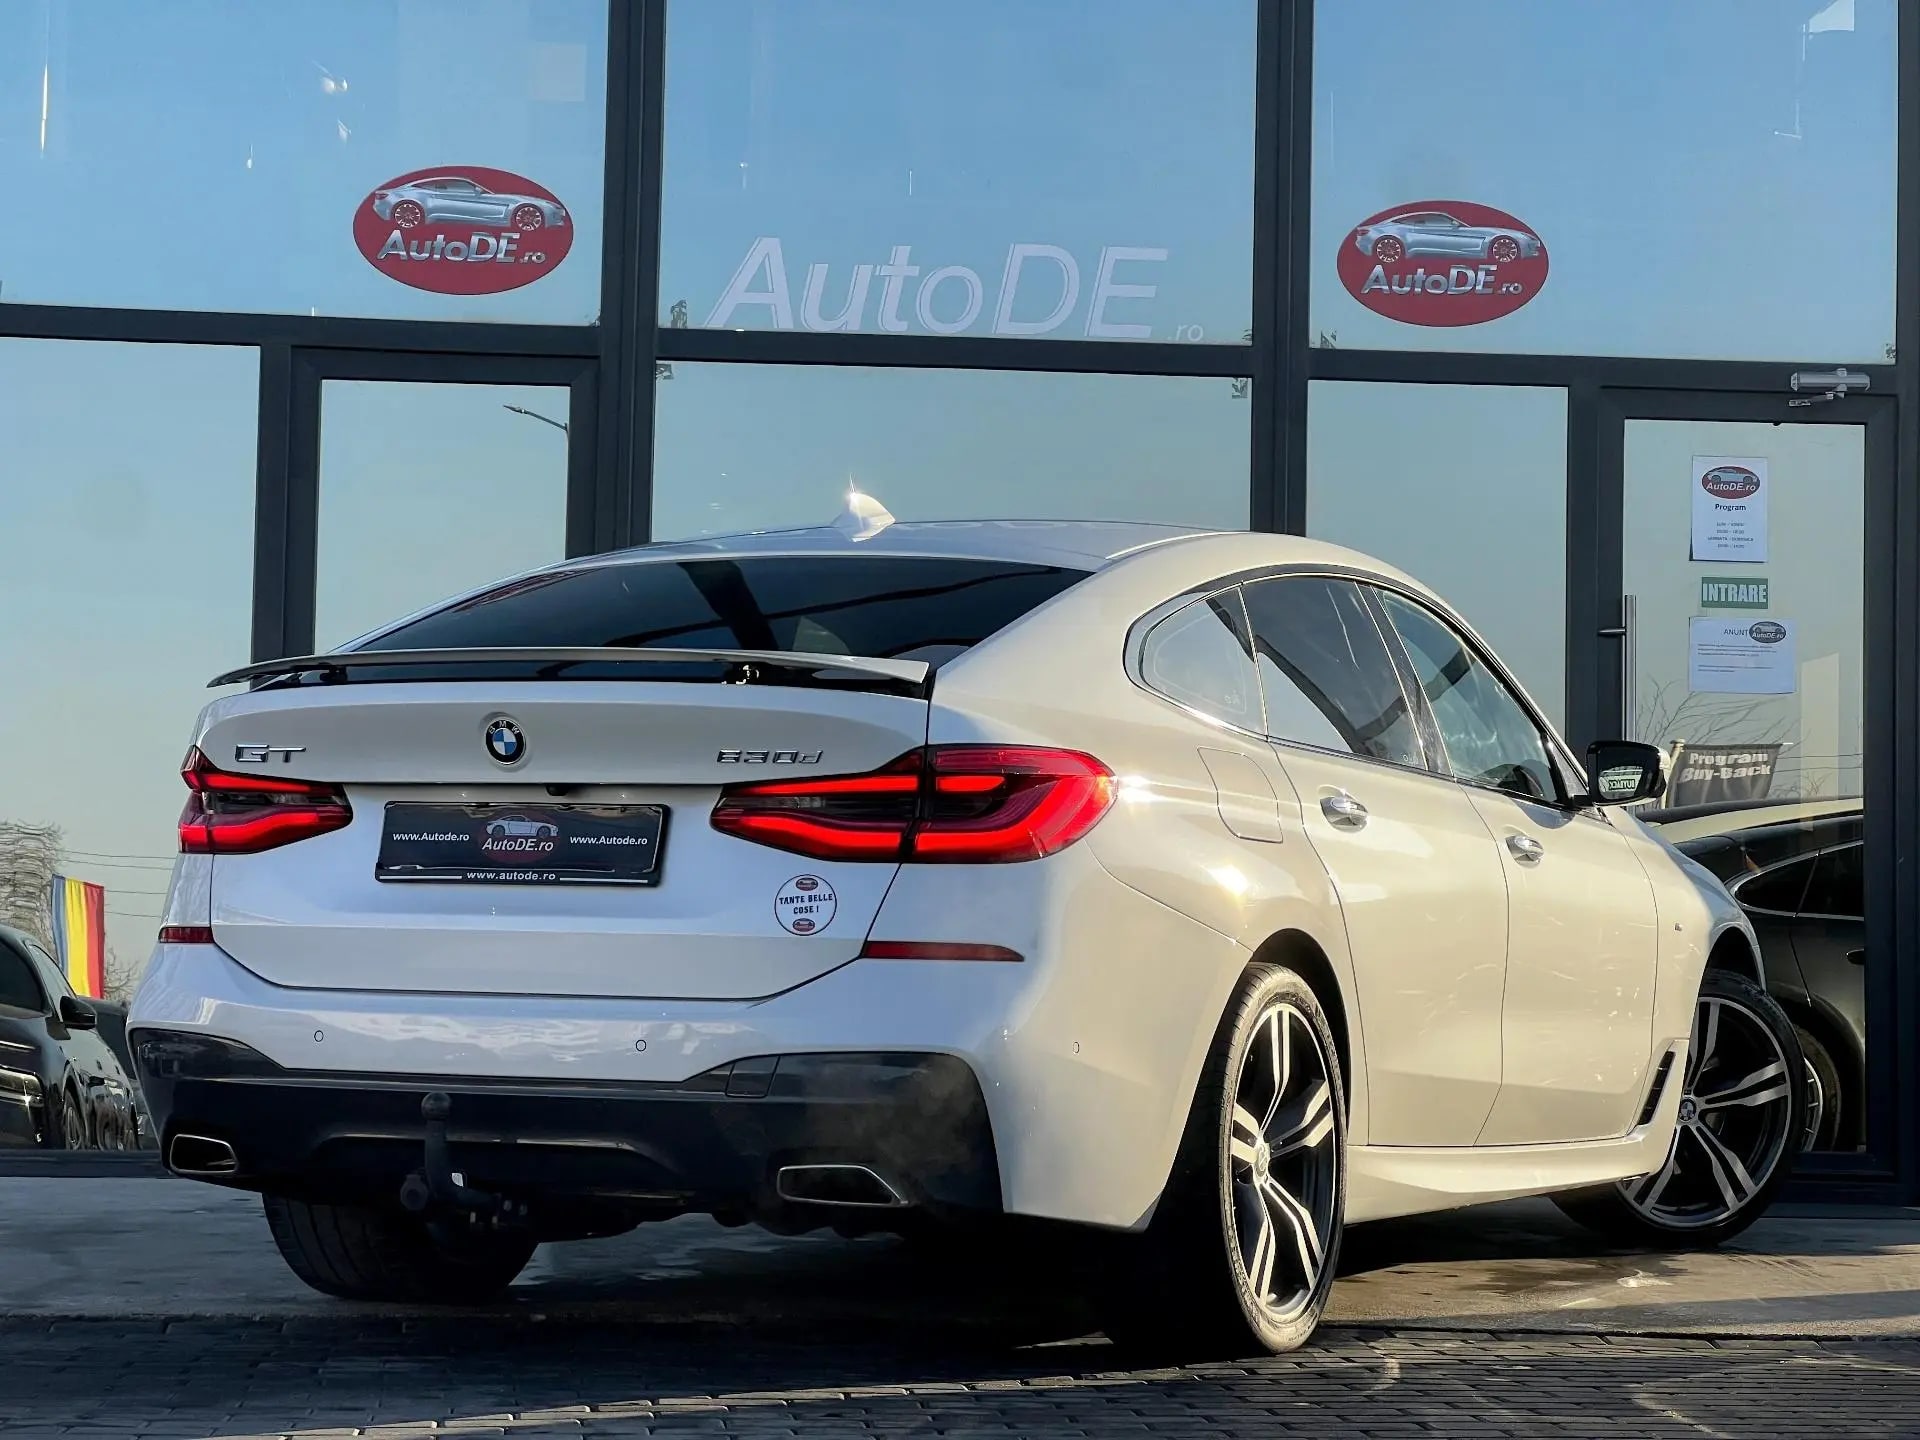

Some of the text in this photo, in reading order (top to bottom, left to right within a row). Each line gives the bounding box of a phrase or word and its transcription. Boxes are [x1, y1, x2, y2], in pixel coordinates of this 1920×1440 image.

[1706, 482, 1756, 491] AutoDE.ro
[1715, 503, 1747, 511] Program
[1702, 583, 1767, 602] INTRARE
[235, 744, 306, 763] GT
[716, 749, 824, 764] 630d
[1689, 753, 1768, 765] Program
[1680, 765, 1771, 782] Buy-Back
[392, 831, 470, 842] www.Autode.ro
[569, 835, 648, 846] www.Autode.ro
[482, 837, 555, 852] AutoDE.ro
[466, 871, 556, 881] www.autode.ro
[779, 893, 833, 905] TANTE BELLE
[793, 906, 814, 915] COSE
